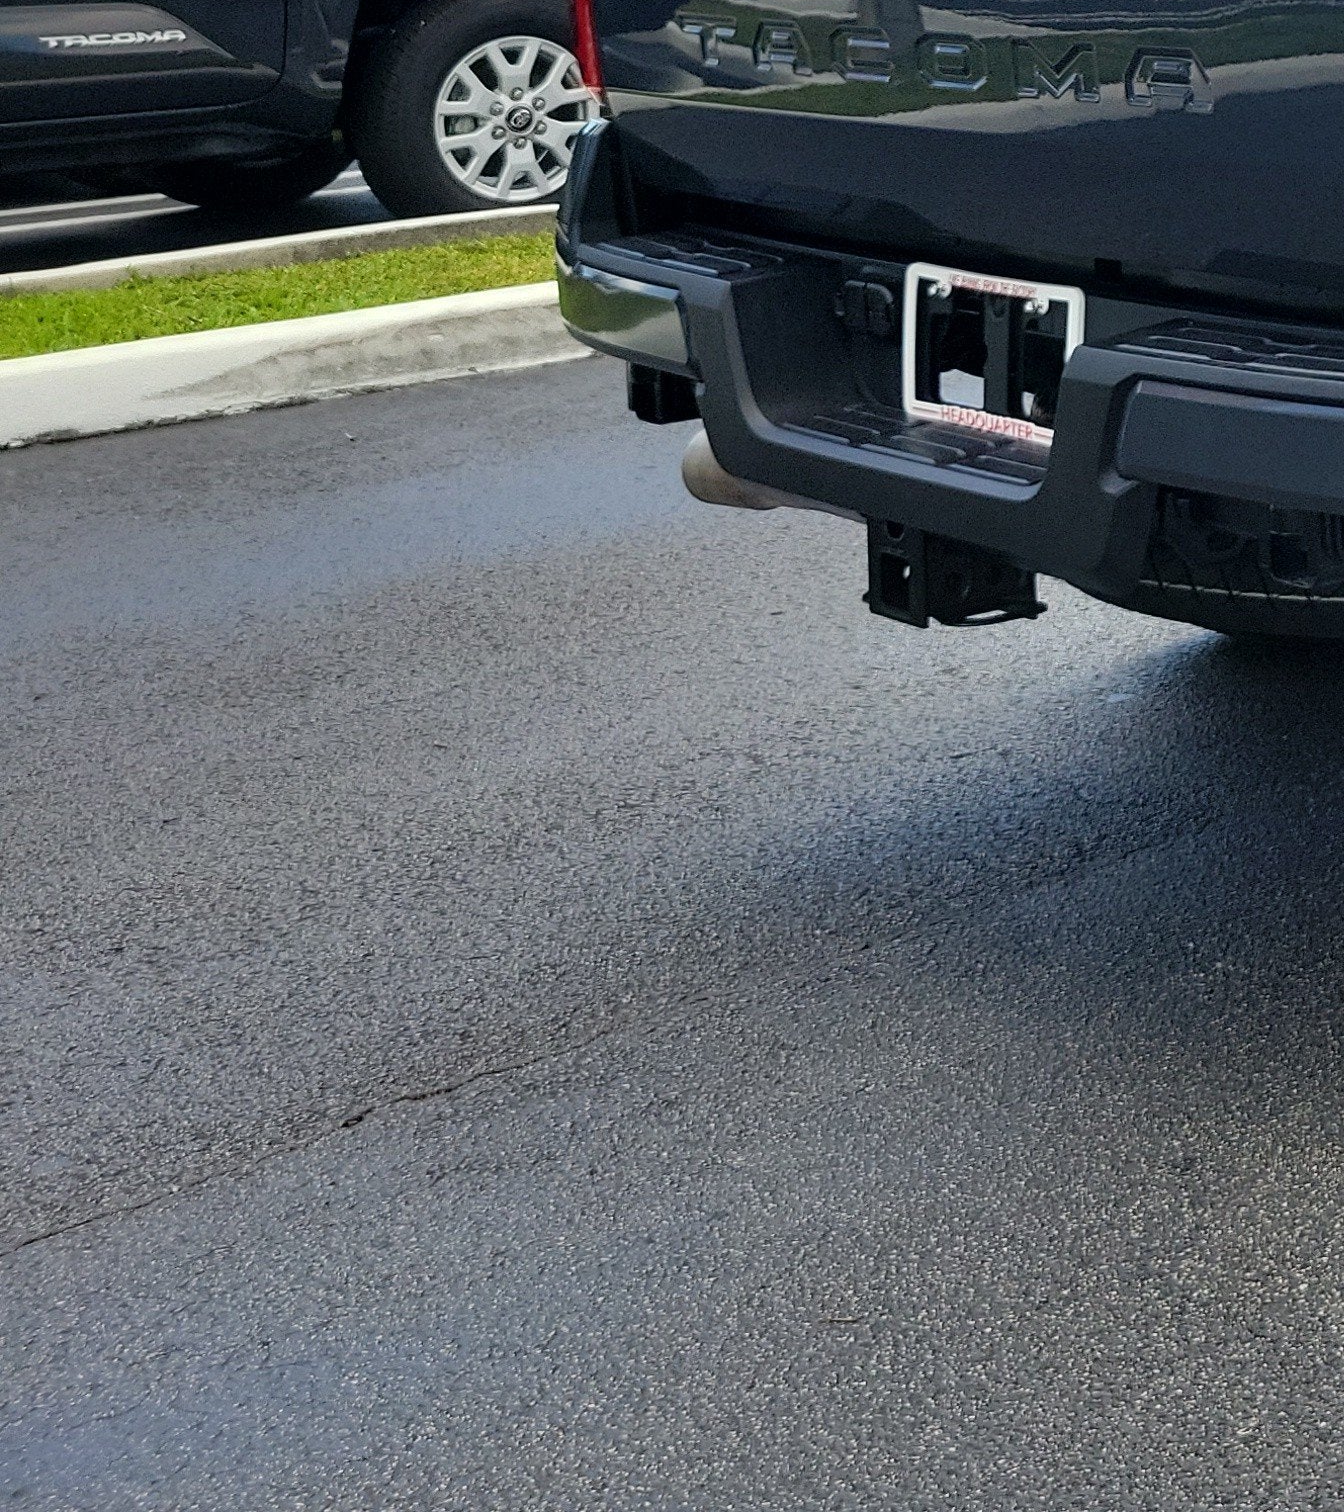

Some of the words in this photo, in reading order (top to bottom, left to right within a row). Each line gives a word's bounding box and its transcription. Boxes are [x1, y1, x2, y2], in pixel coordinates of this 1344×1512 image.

[38, 29, 186, 48] TACOMA
[678, 13, 1215, 114] TACOMA
[941, 405, 1033, 438] HEADQUARTER
